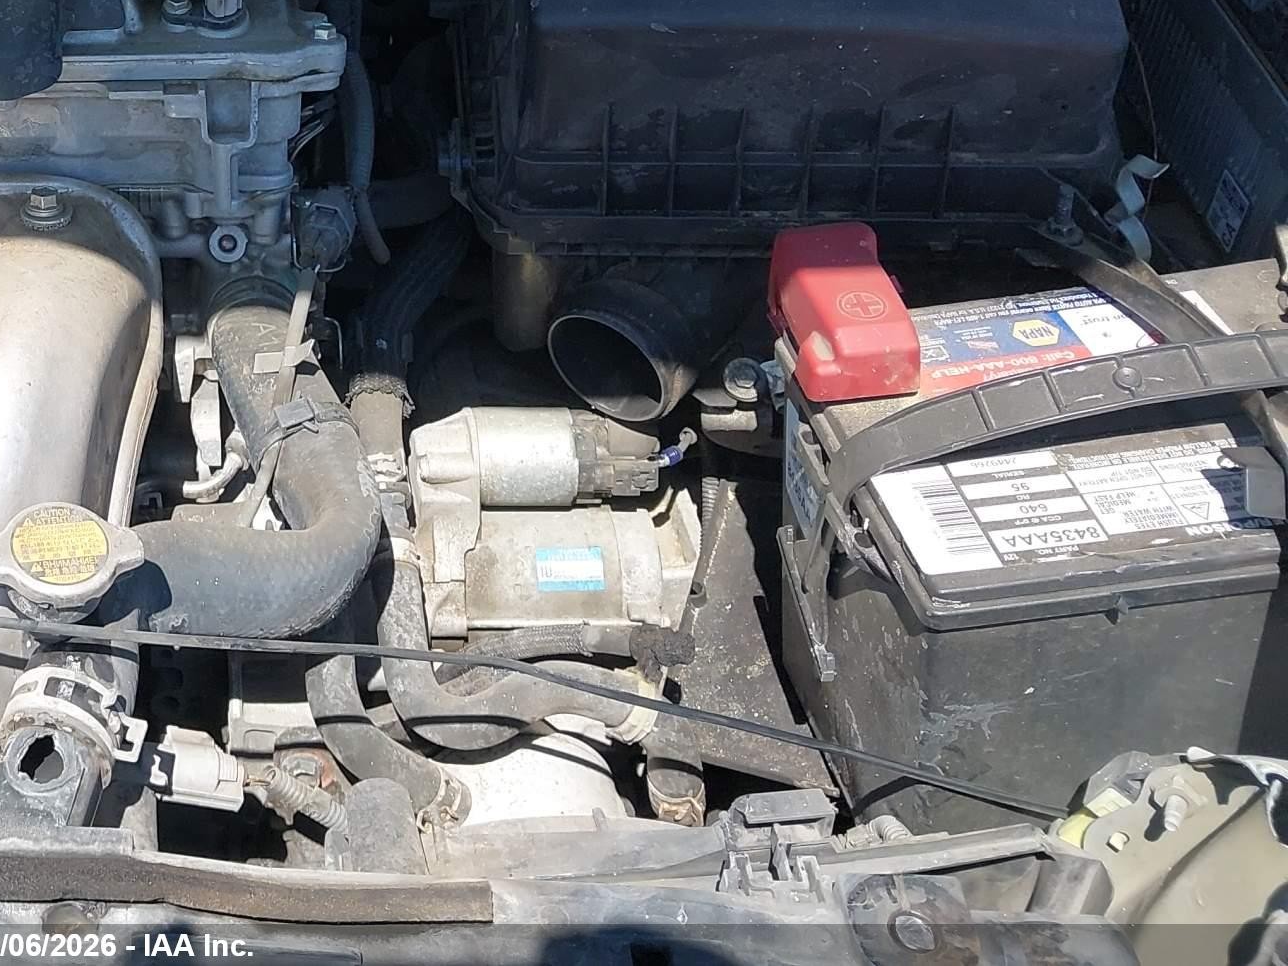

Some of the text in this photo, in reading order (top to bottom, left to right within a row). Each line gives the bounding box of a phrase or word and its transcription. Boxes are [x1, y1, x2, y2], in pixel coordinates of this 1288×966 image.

[1019, 325, 1053, 341] NAPA
[930, 348, 1075, 379] Call: 800-AAA-HELP
[991, 469, 1024, 480] SERIAL
[1011, 481, 1029, 493] 95
[1016, 493, 1030, 501] RC
[1094, 490, 1136, 502] HELP FAST
[1018, 502, 1048, 516] 640
[1095, 497, 1130, 509] MEDICAL
[33, 508, 71, 518] CAUTION
[1122, 505, 1173, 518] WITH WATER
[1040, 514, 1062, 523] CCA
[1122, 511, 1178, 525] IMMEDIATELY
[1134, 517, 1183, 530] FLUSH EYES
[1001, 522, 1100, 551] 8435AAA
[1034, 544, 1079, 556] PART NO.
